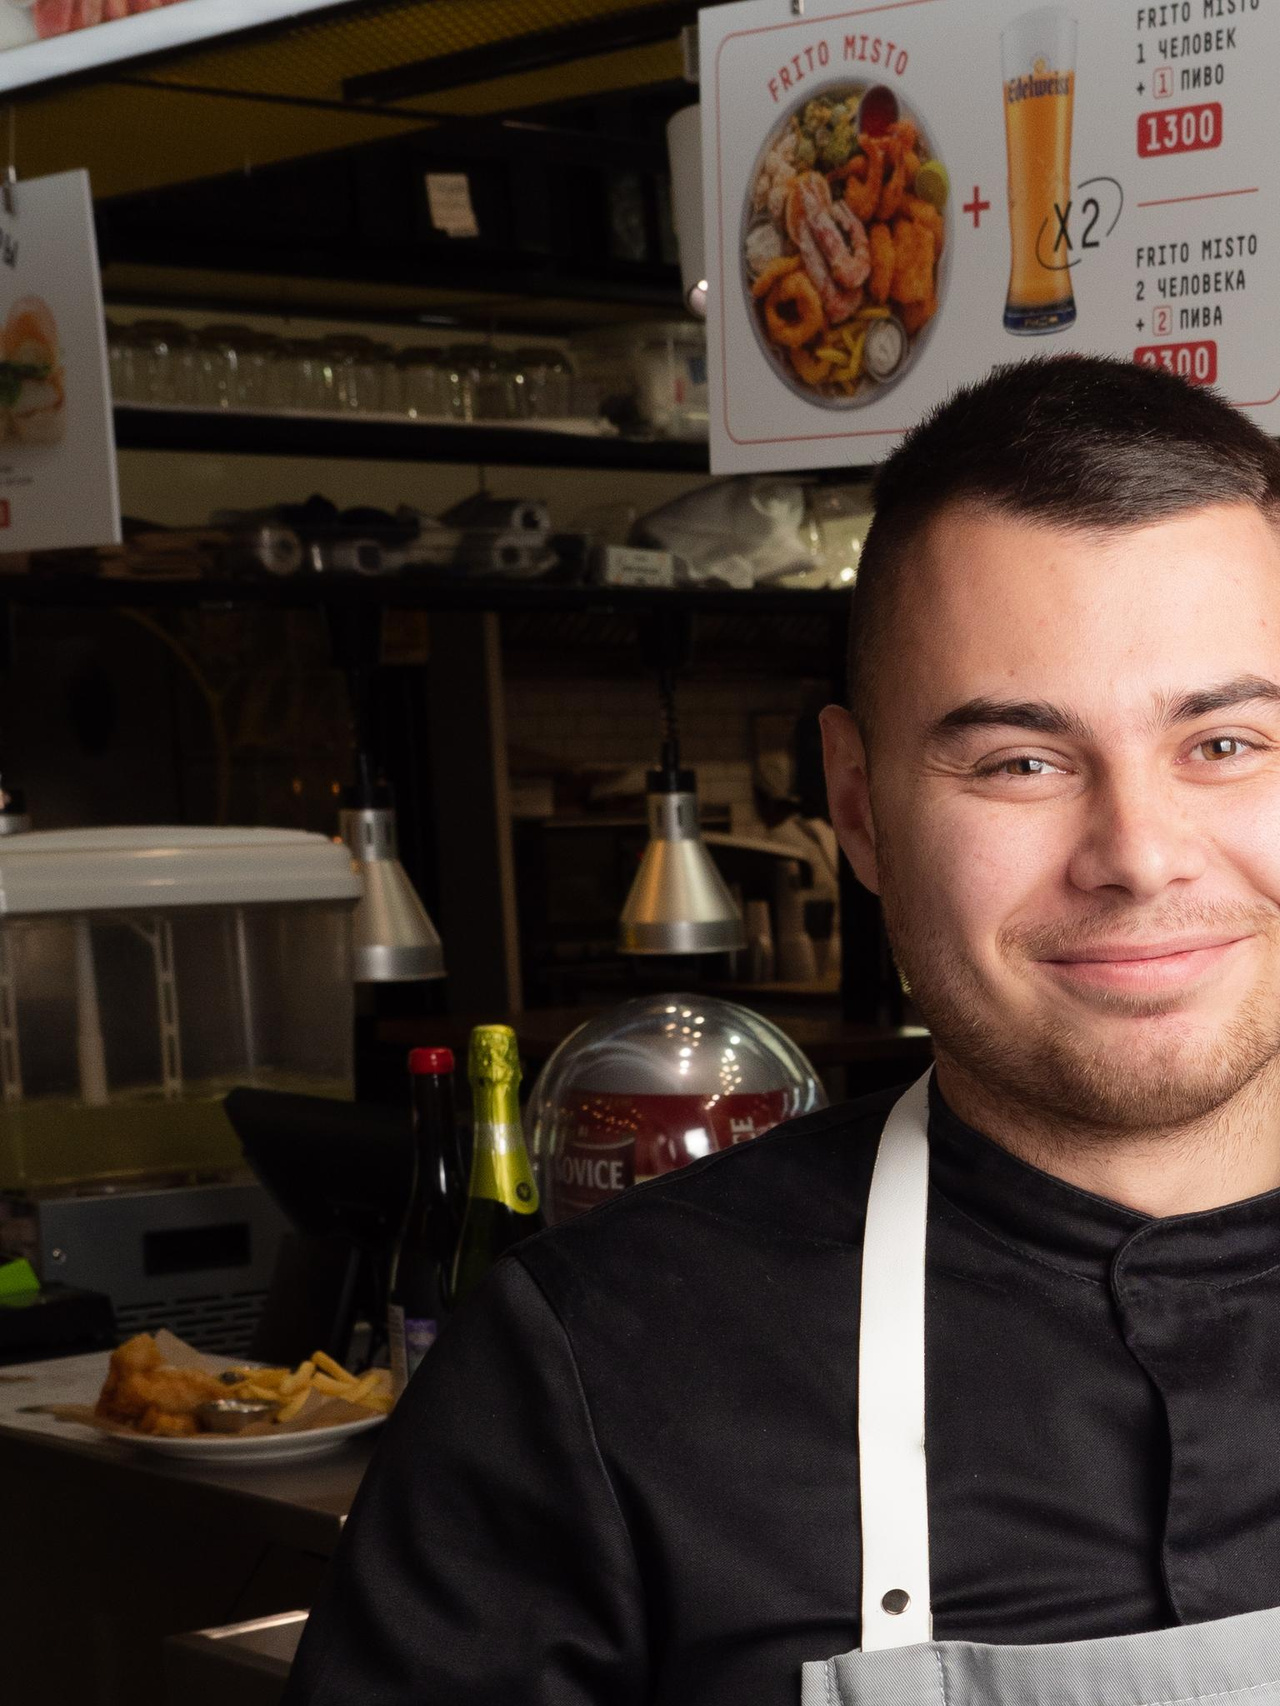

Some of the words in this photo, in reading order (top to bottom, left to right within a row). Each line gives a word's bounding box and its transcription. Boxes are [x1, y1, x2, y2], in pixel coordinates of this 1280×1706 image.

[1137, 1, 1191, 30] FRITO
[1136, 43, 1145, 64] 1
[1158, 27, 1236, 59] ЧЕЛОВЕК
[768, 40, 829, 102] FRITO
[843, 33, 908, 76] MISTO
[1181, 63, 1224, 91] ПИВО
[1146, 109, 1214, 152] 1300
[1136, 242, 1190, 268] FRITO
[1202, 234, 1258, 261] MISTO
[1136, 281, 1145, 301] 2
[1158, 269, 1246, 298] ЧЕЛОВЕКА
[1180, 305, 1223, 330] ПИВА
